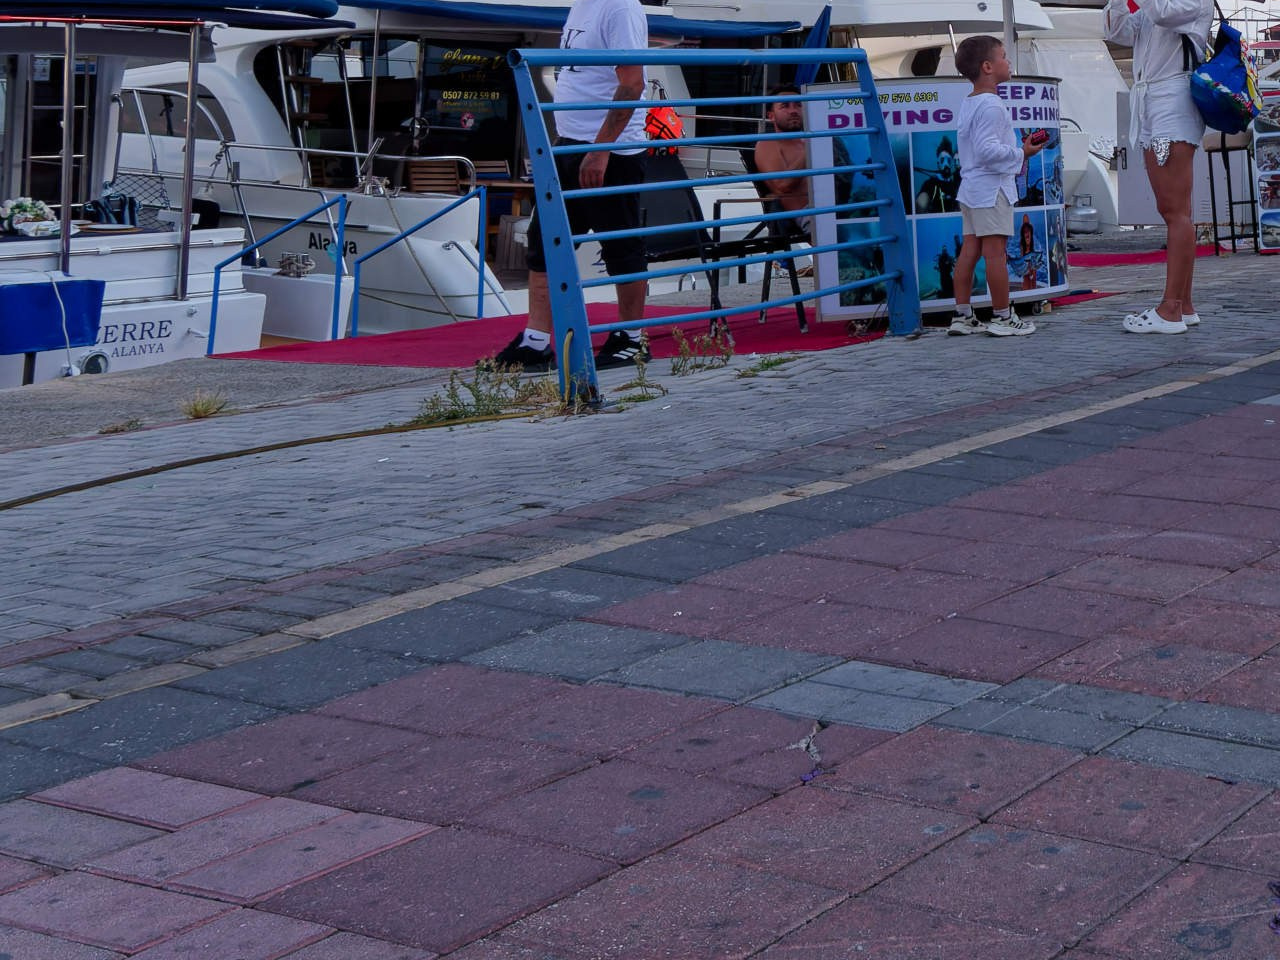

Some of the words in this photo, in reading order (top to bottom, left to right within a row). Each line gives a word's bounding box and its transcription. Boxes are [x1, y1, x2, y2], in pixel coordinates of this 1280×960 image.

[463, 91, 478, 100] 872
[892, 93, 911, 104] 576
[913, 92, 938, 102] 6381
[111, 343, 164, 358] ALANYA
